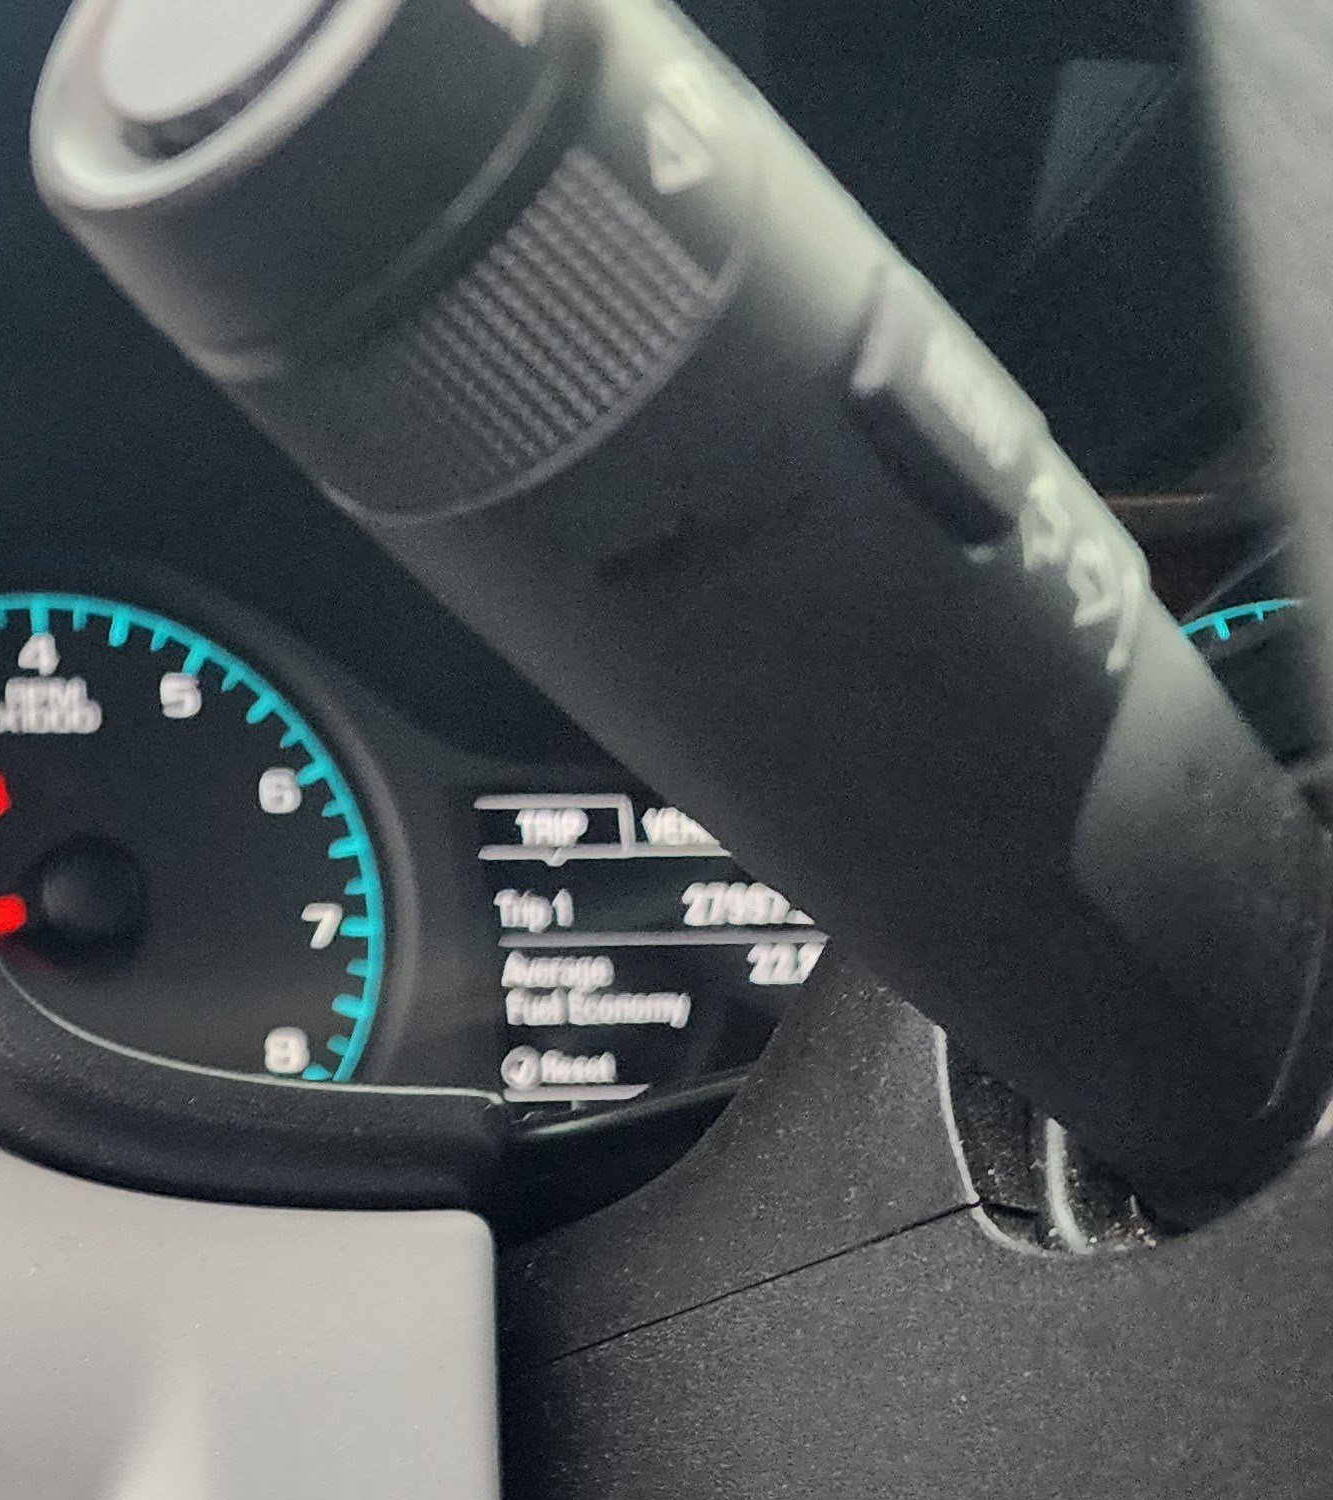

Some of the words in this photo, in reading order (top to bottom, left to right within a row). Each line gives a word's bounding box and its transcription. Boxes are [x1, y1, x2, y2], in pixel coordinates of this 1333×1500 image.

[18, 632, 60, 676] 4
[160, 672, 202, 719] 5
[258, 767, 302, 814] 6
[514, 807, 589, 847] TRIP
[301, 902, 343, 950] 7
[493, 888, 553, 933] Trip
[552, 888, 574, 928] 1
[500, 951, 616, 993] Average
[505, 987, 568, 1027] Fuel
[568, 988, 692, 1029] Economy
[264, 1027, 310, 1075] 8
[540, 1048, 618, 1084] Reset
